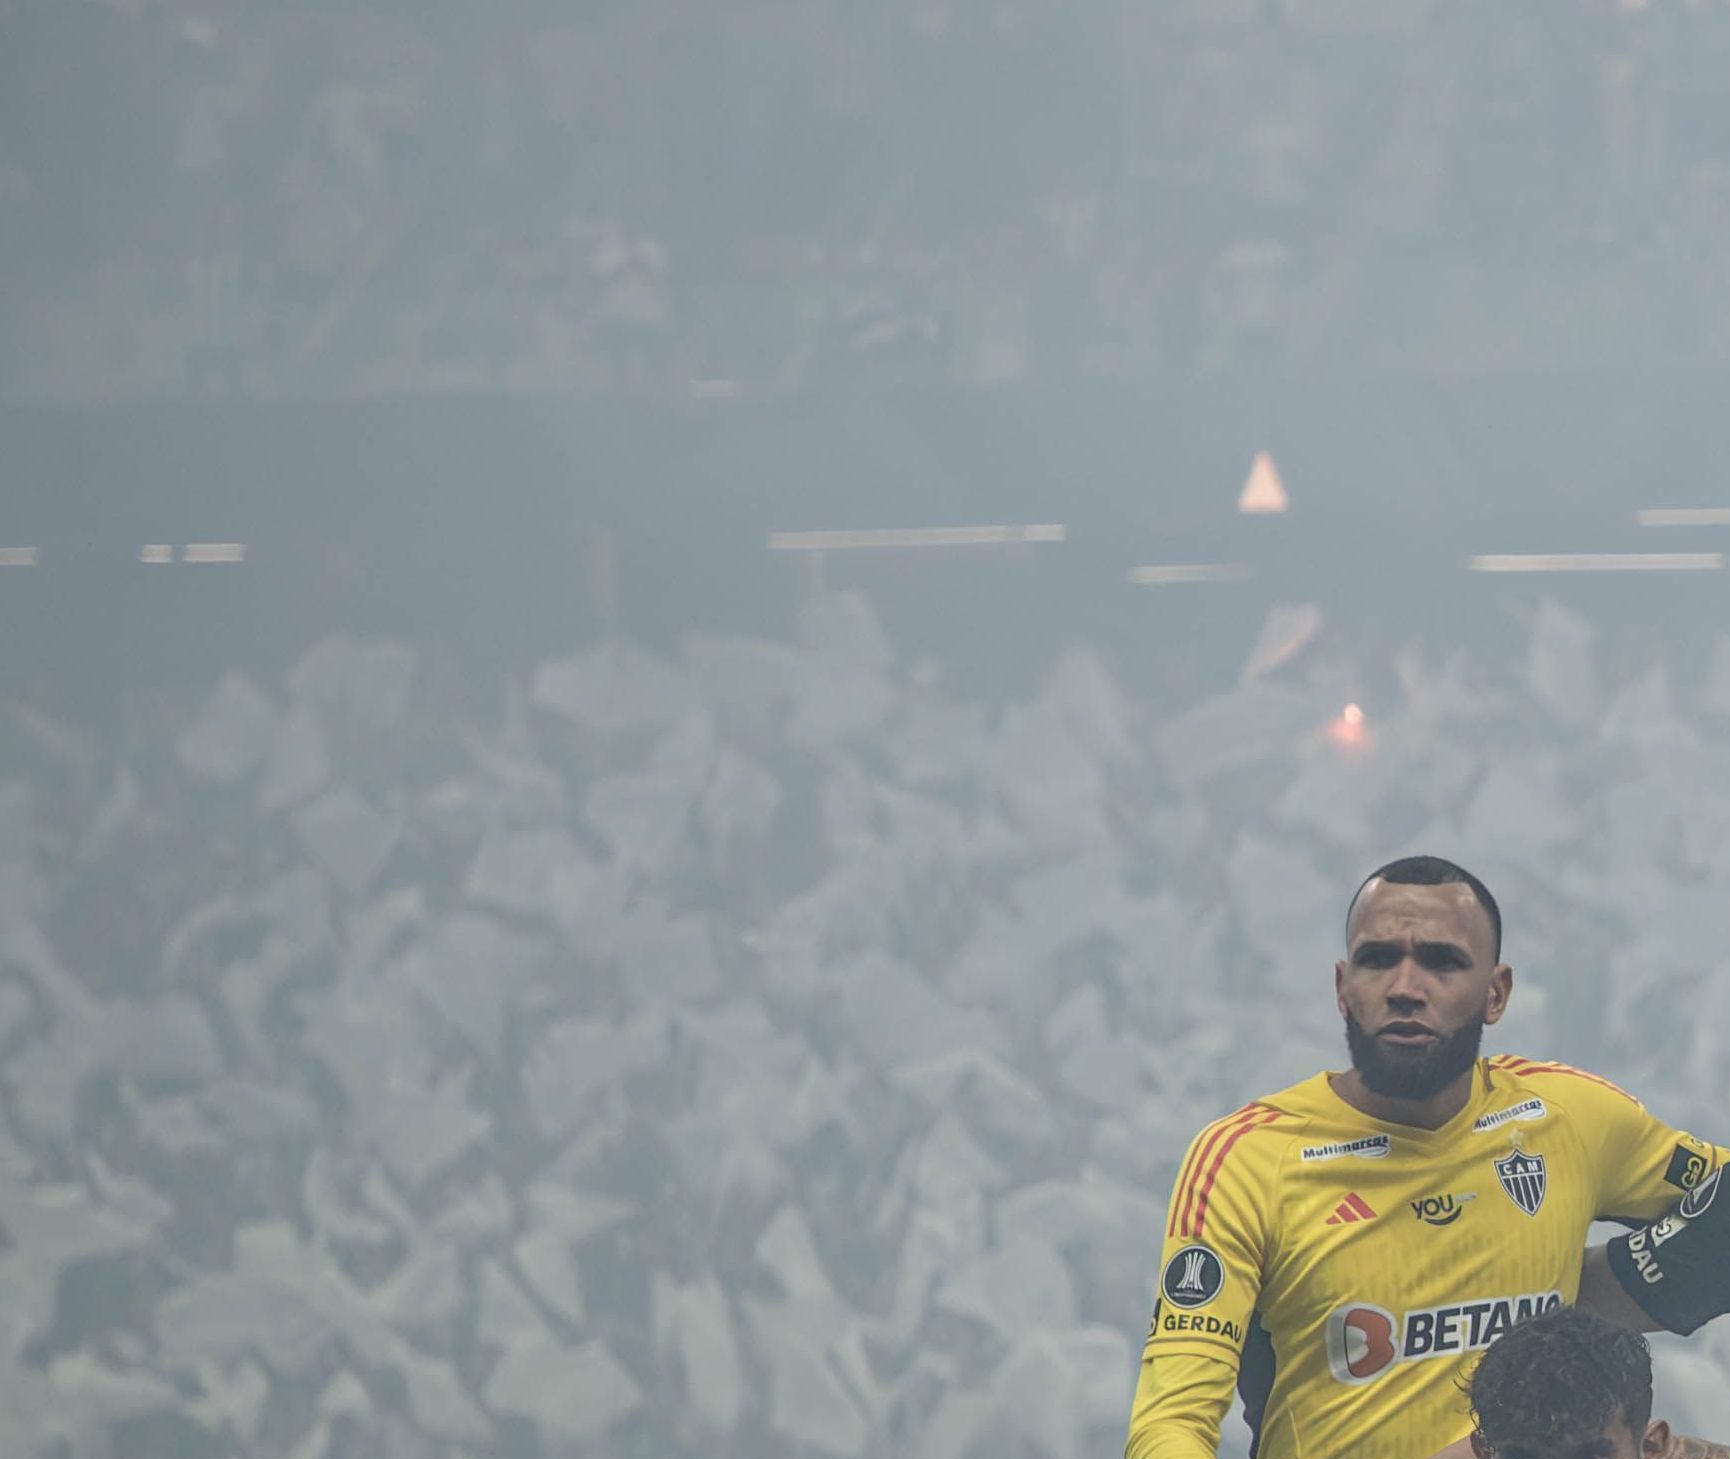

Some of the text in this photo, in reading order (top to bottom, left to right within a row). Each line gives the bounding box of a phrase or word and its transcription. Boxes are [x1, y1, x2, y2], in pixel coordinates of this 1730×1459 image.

[1303, 1135, 1389, 1159] Multimarcas
[1502, 1161, 1538, 1175] CAM
[1411, 1194, 1454, 1219] YOU
[1164, 1314, 1242, 1343] GERDAU
